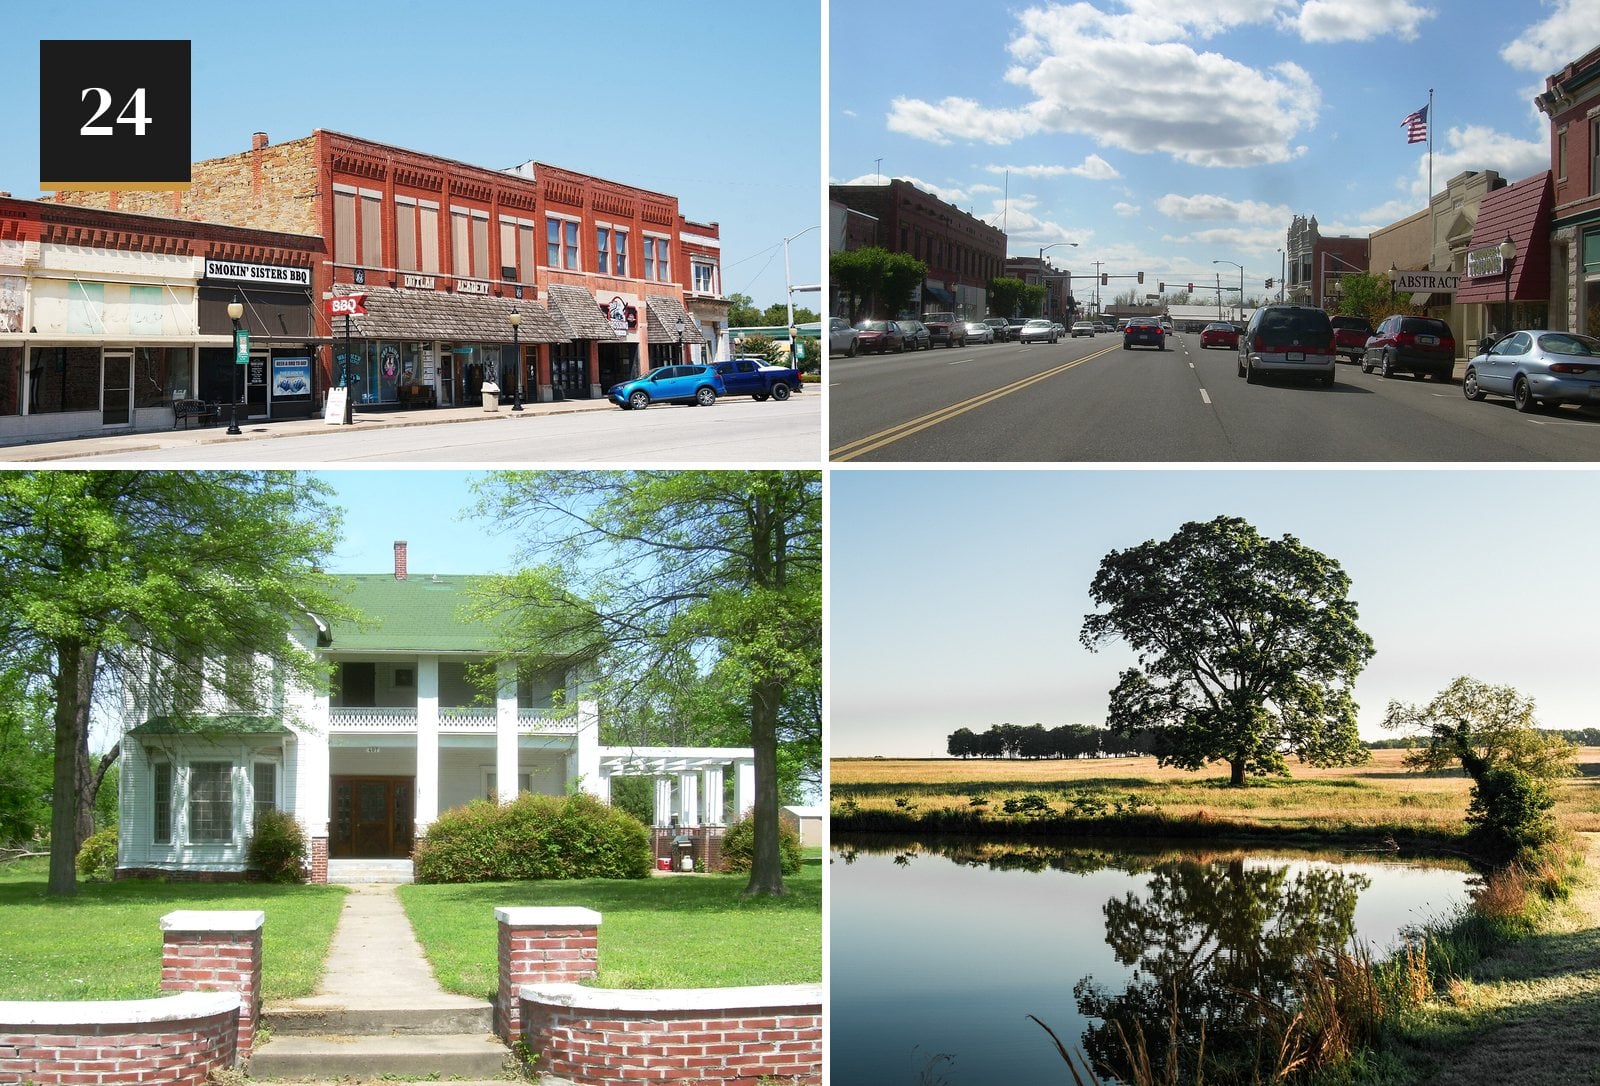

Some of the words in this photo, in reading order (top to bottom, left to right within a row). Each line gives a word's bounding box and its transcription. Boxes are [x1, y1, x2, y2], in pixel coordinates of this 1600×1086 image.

[208, 263, 249, 277] SMOKIN'
[250, 267, 288, 280] SISTERS
[289, 270, 307, 284] BBQ
[332, 298, 357, 313] BBQ
